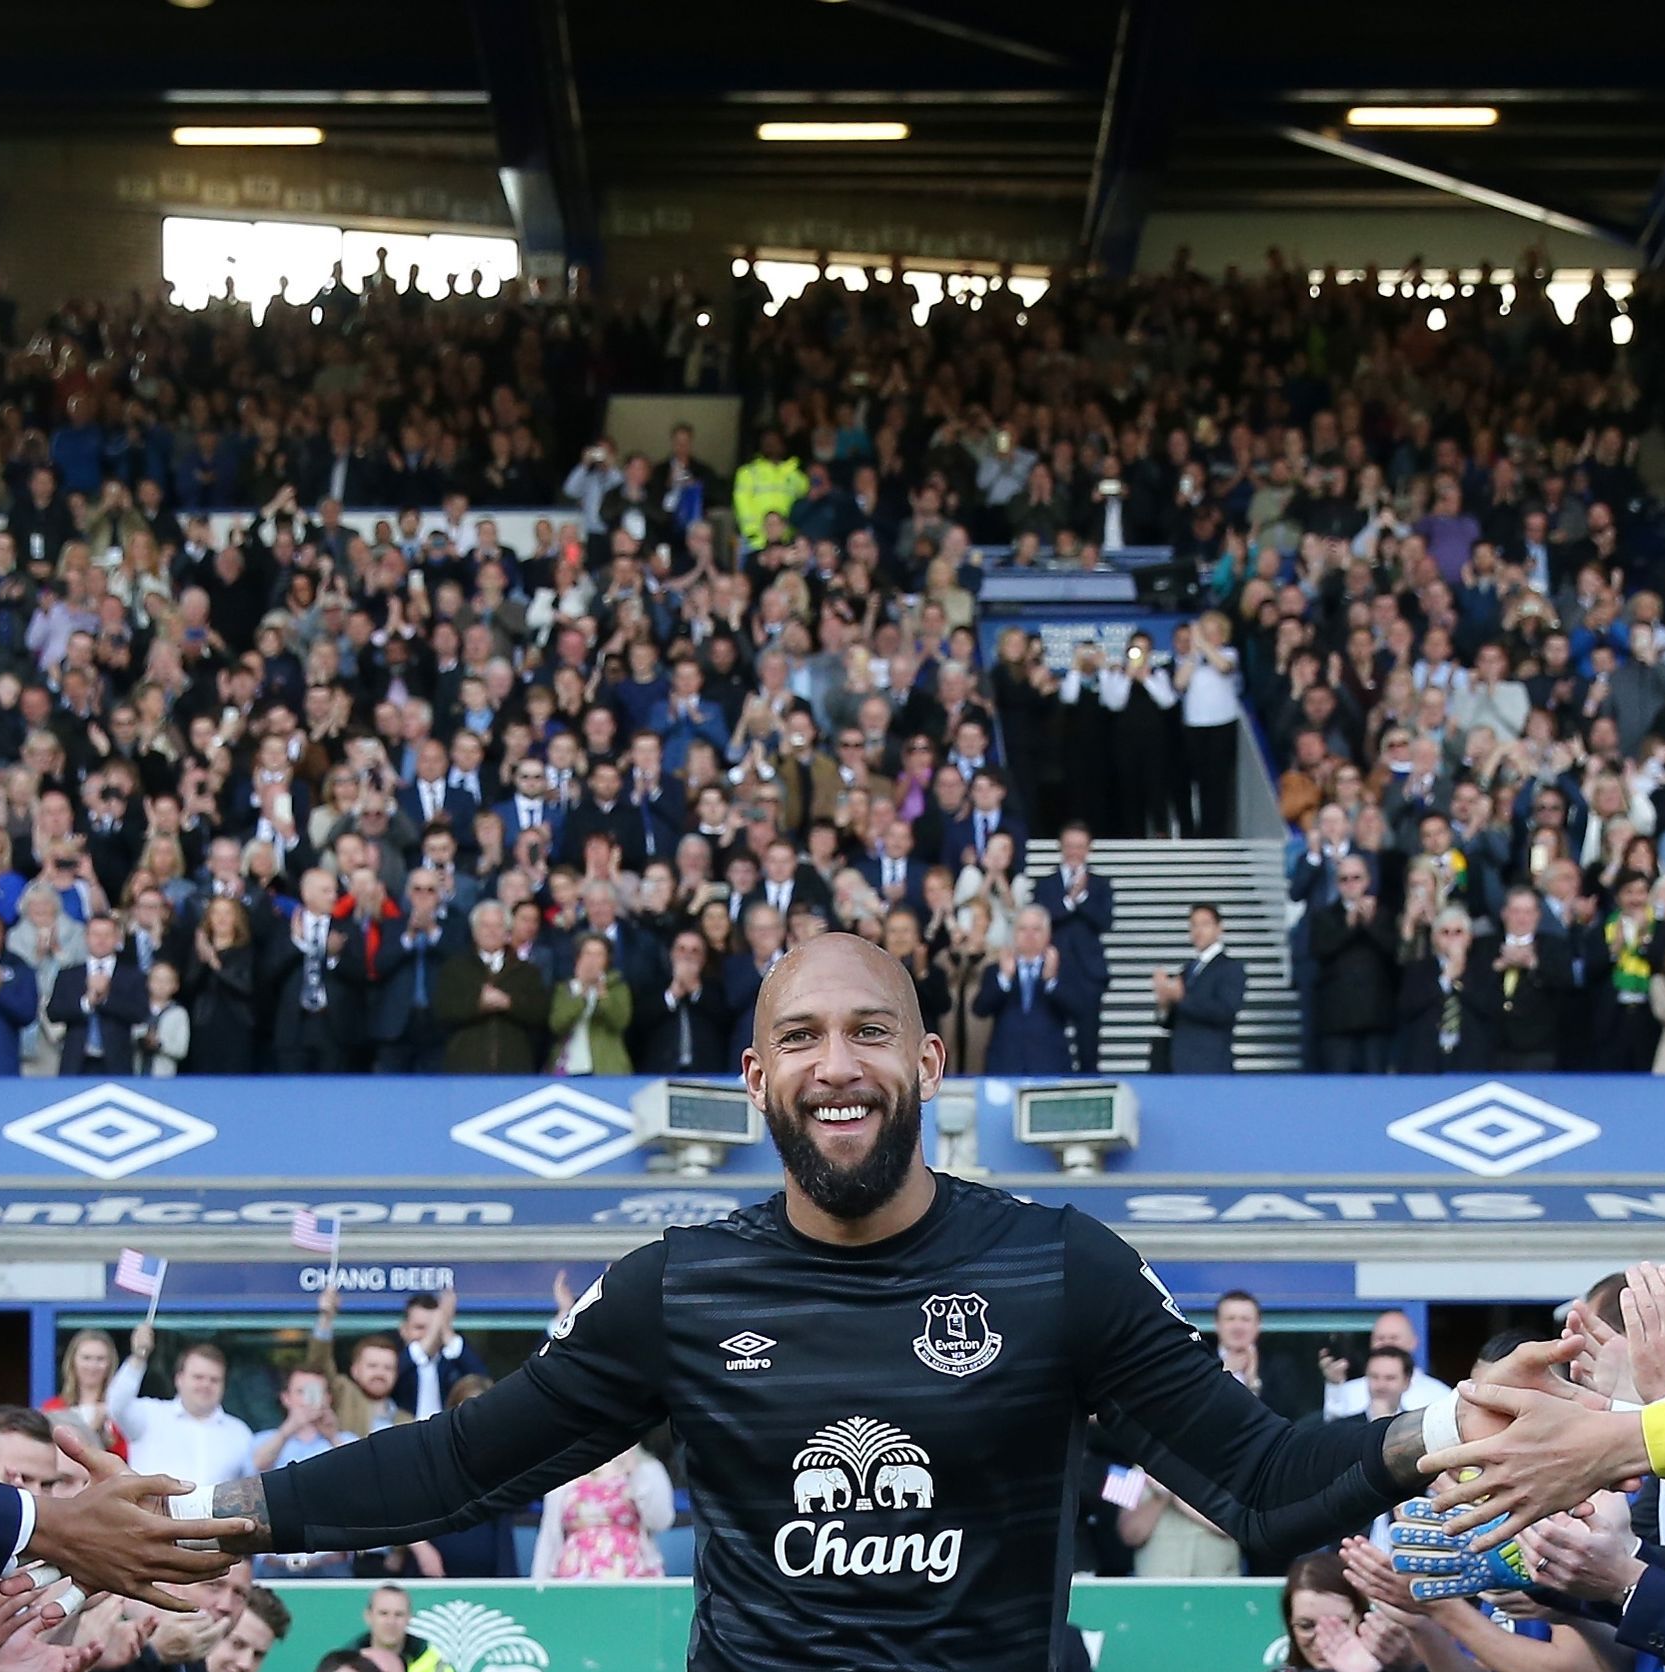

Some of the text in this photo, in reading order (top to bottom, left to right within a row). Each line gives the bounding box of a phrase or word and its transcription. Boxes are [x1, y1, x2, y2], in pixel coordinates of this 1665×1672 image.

[1126, 1193, 1544, 1224] SATIS
[299, 1266, 456, 1291] CHANG BEER
[935, 1340, 981, 1351] Everton
[725, 1355, 772, 1371] umbro
[773, 1520, 964, 1584] Chang
